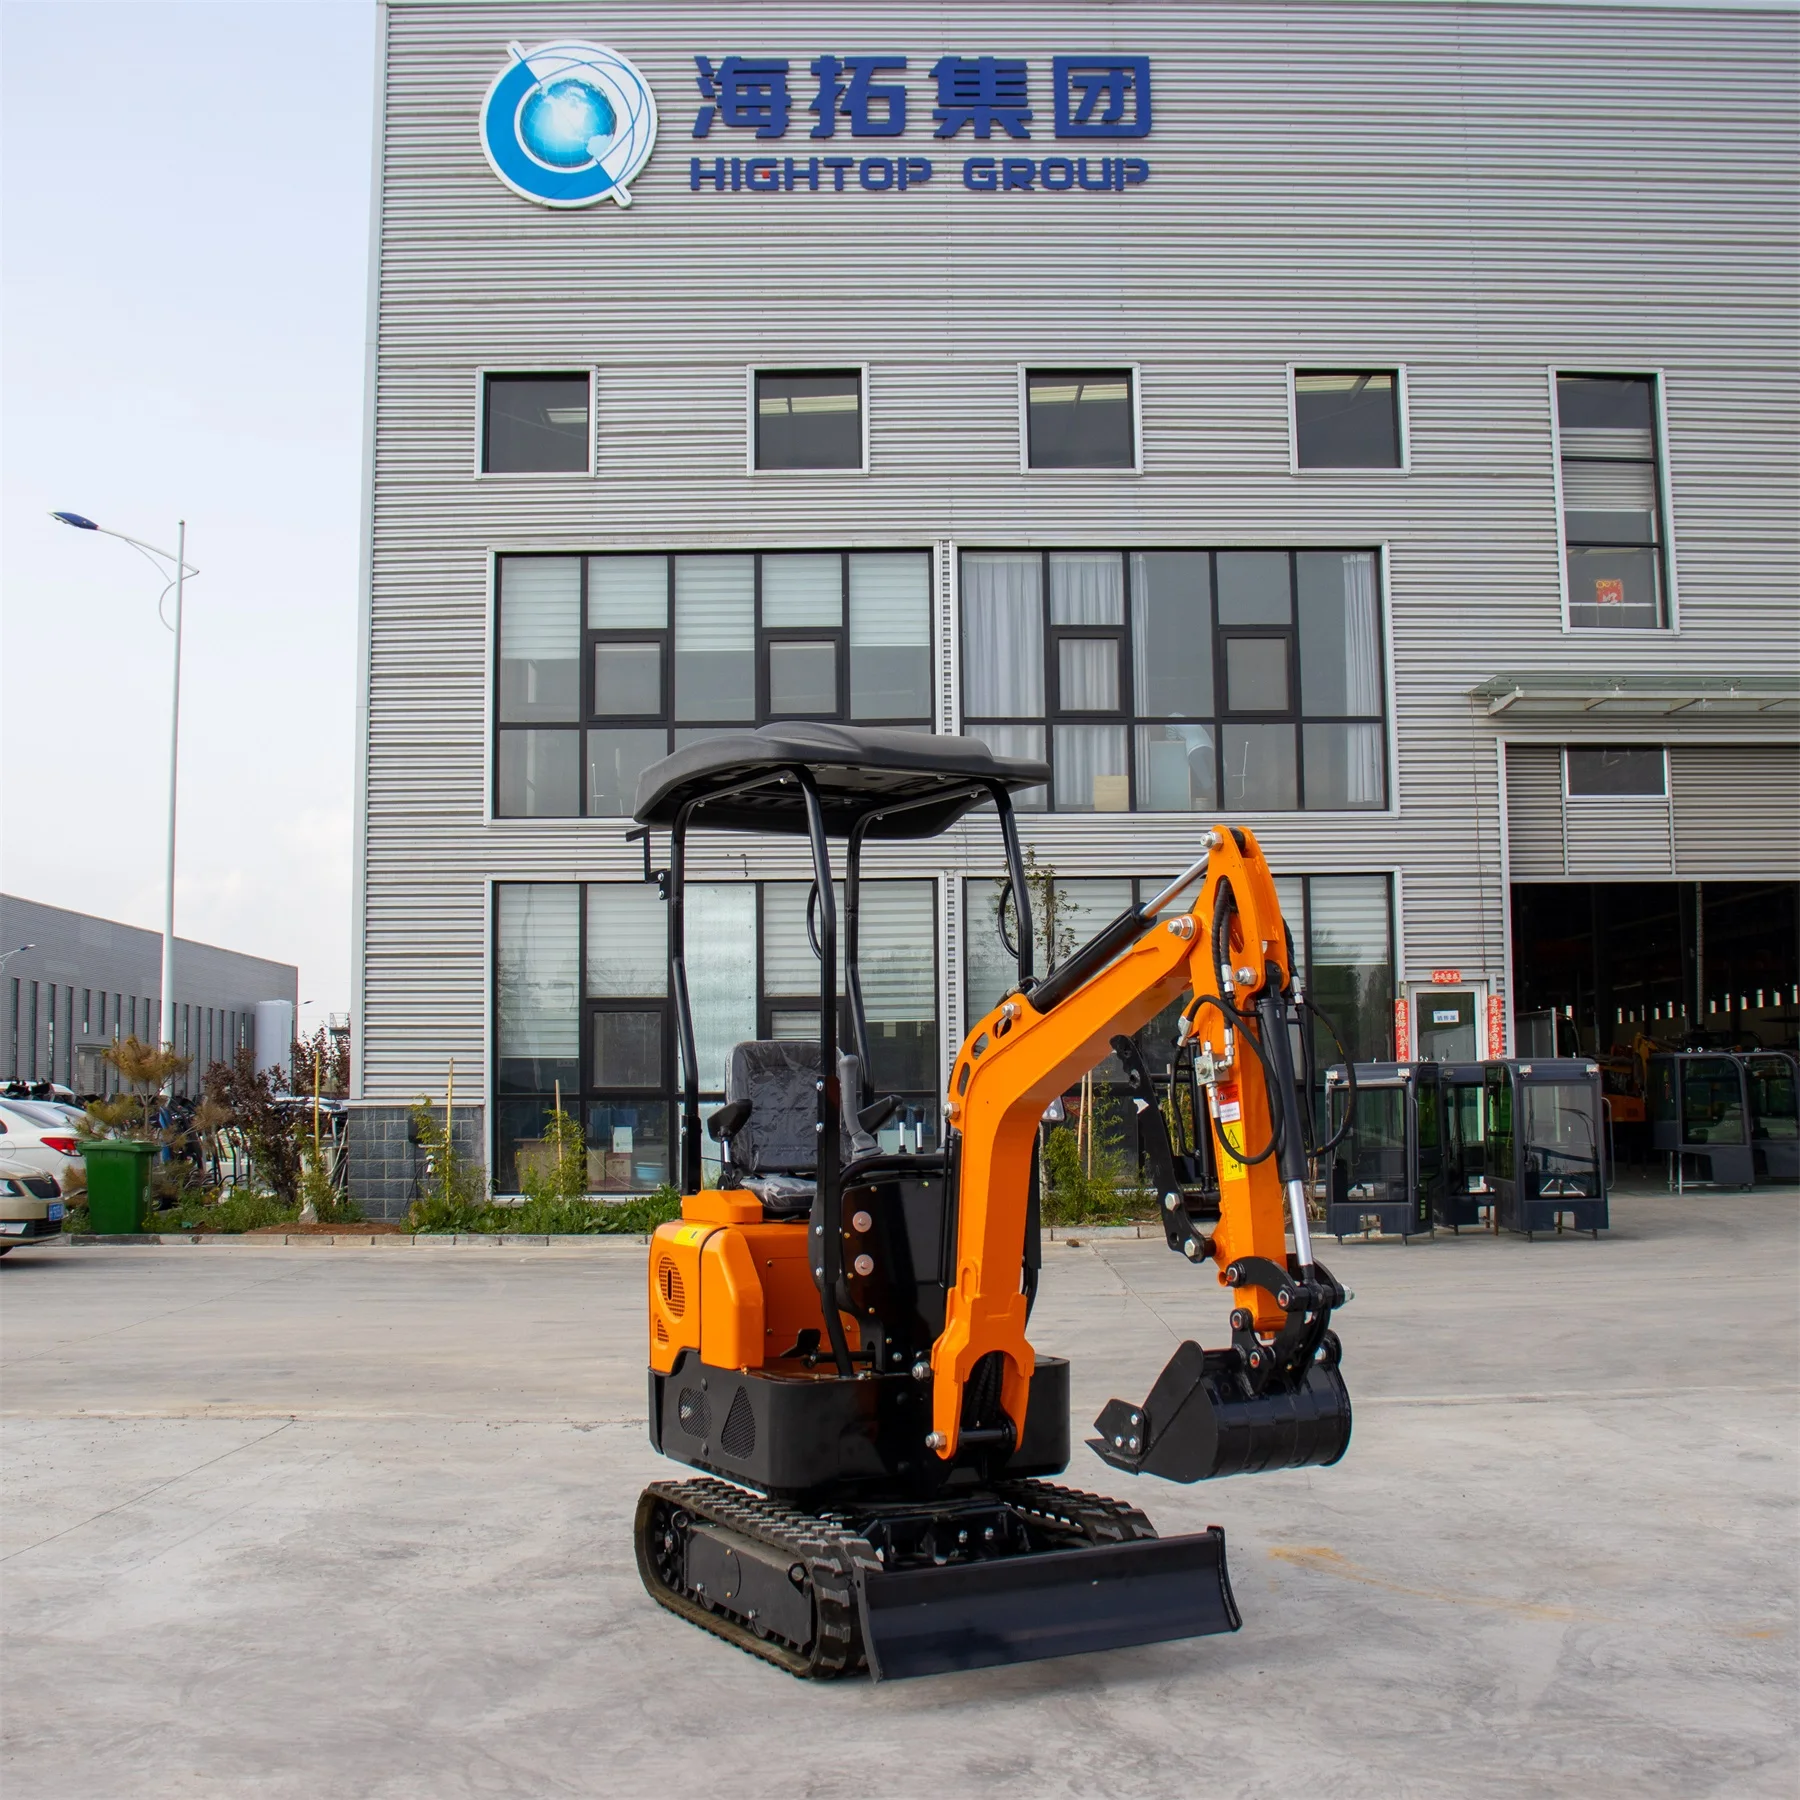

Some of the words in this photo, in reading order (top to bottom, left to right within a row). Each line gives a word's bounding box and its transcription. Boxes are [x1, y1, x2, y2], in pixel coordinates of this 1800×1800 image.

[693, 55, 1151, 139] 海拓集团
[690, 156, 931, 192] HIGHTOP
[963, 156, 1149, 192] GROUP
